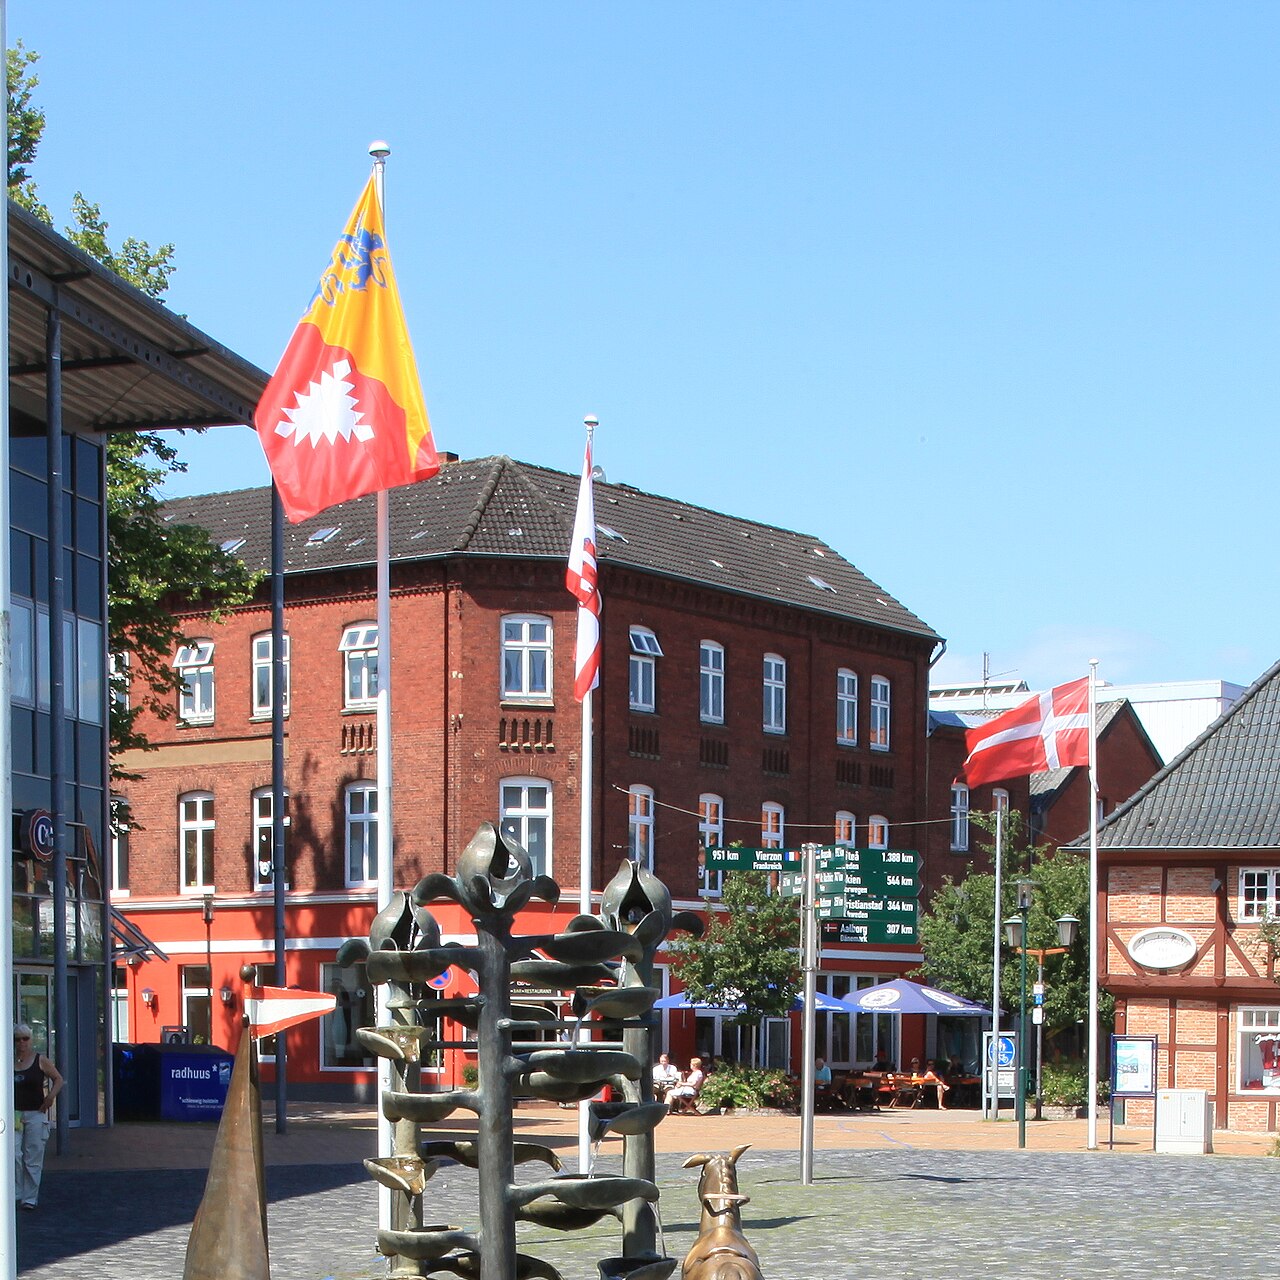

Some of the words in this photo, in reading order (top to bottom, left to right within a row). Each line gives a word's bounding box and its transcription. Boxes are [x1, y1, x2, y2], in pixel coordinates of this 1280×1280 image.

[712, 850, 725, 861] 951
[727, 850, 739, 860] km
[755, 850, 782, 861] Vierzon
[902, 853, 914, 863] km
[752, 862, 782, 870] Frankreich
[886, 875, 900, 886] 544
[901, 875, 913, 886] km
[887, 900, 900, 911] 344
[901, 901, 914, 912] km
[840, 924, 868, 936] Aalborg
[886, 923, 900, 934] 307
[901, 924, 913, 934] km
